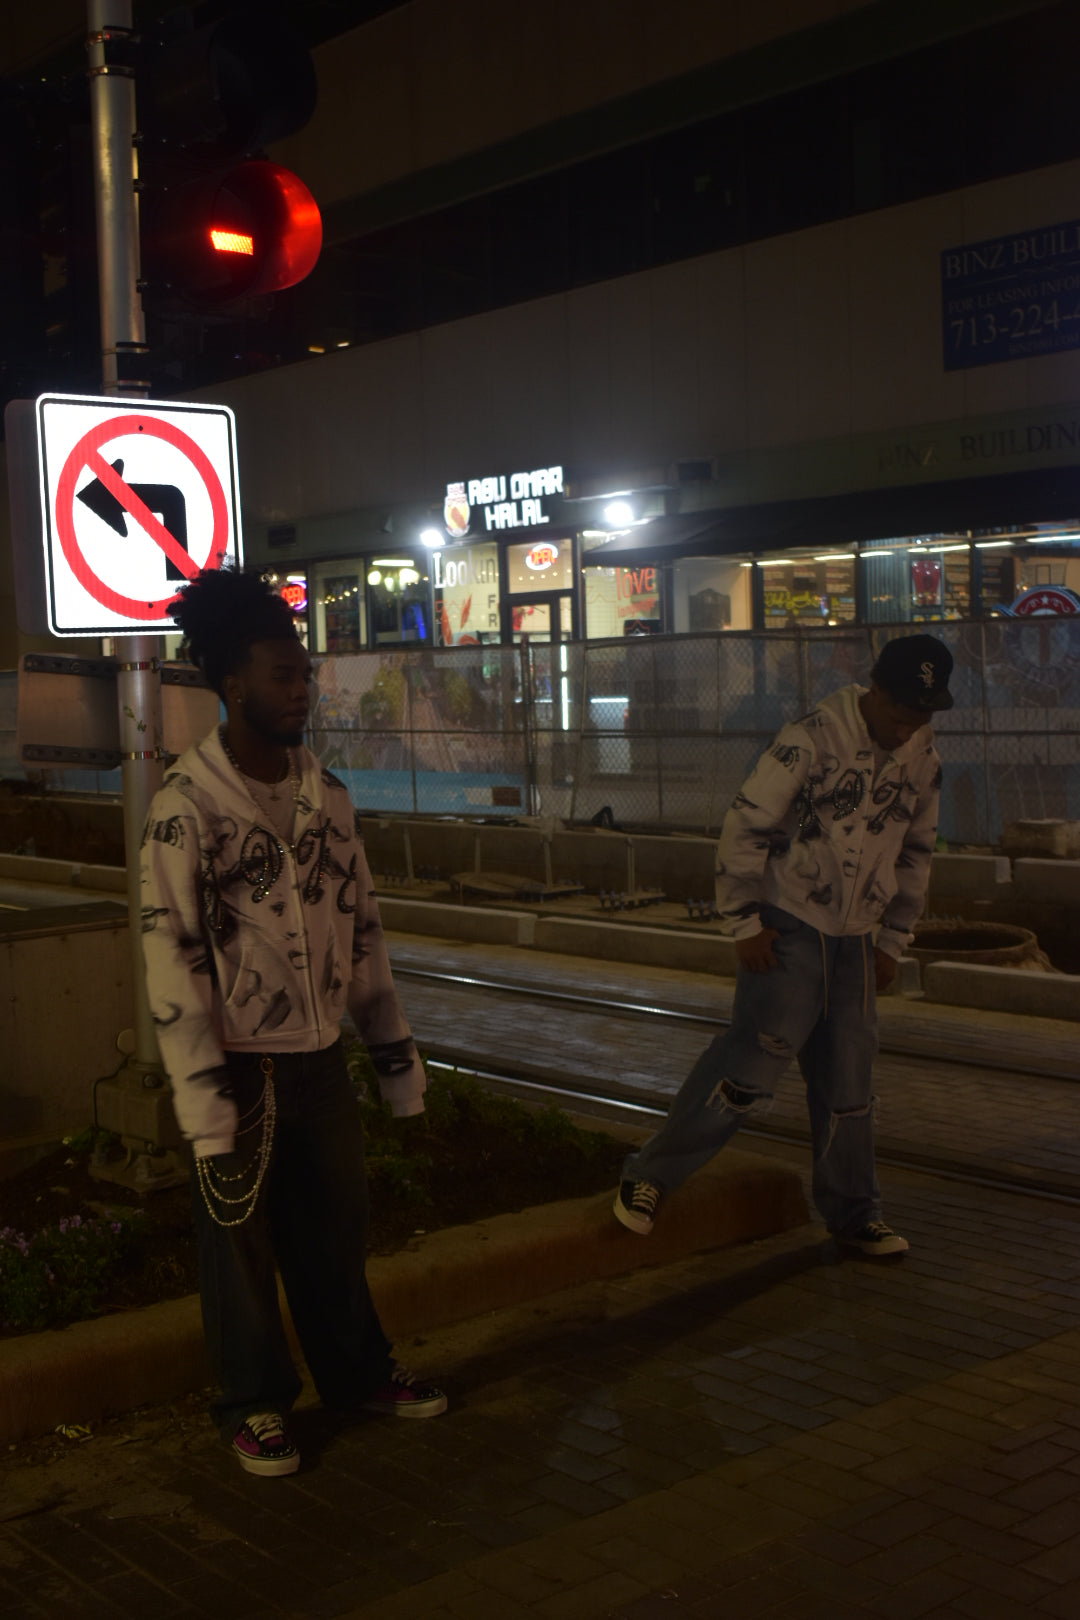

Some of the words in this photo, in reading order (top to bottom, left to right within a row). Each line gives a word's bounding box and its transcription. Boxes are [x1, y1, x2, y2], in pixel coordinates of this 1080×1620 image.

[945, 244, 1004, 279] BINZ
[1013, 226, 1080, 265] BUIL
[949, 297, 975, 315] FOR
[977, 283, 1038, 309] LEASING
[960, 420, 1080, 461] BUILDIN
[468, 475, 507, 506] ABU
[510, 465, 564, 500] OMAR
[484, 498, 549, 531] HALAL
[528, 547, 557, 566] OPEN
[616, 566, 655, 601] love
